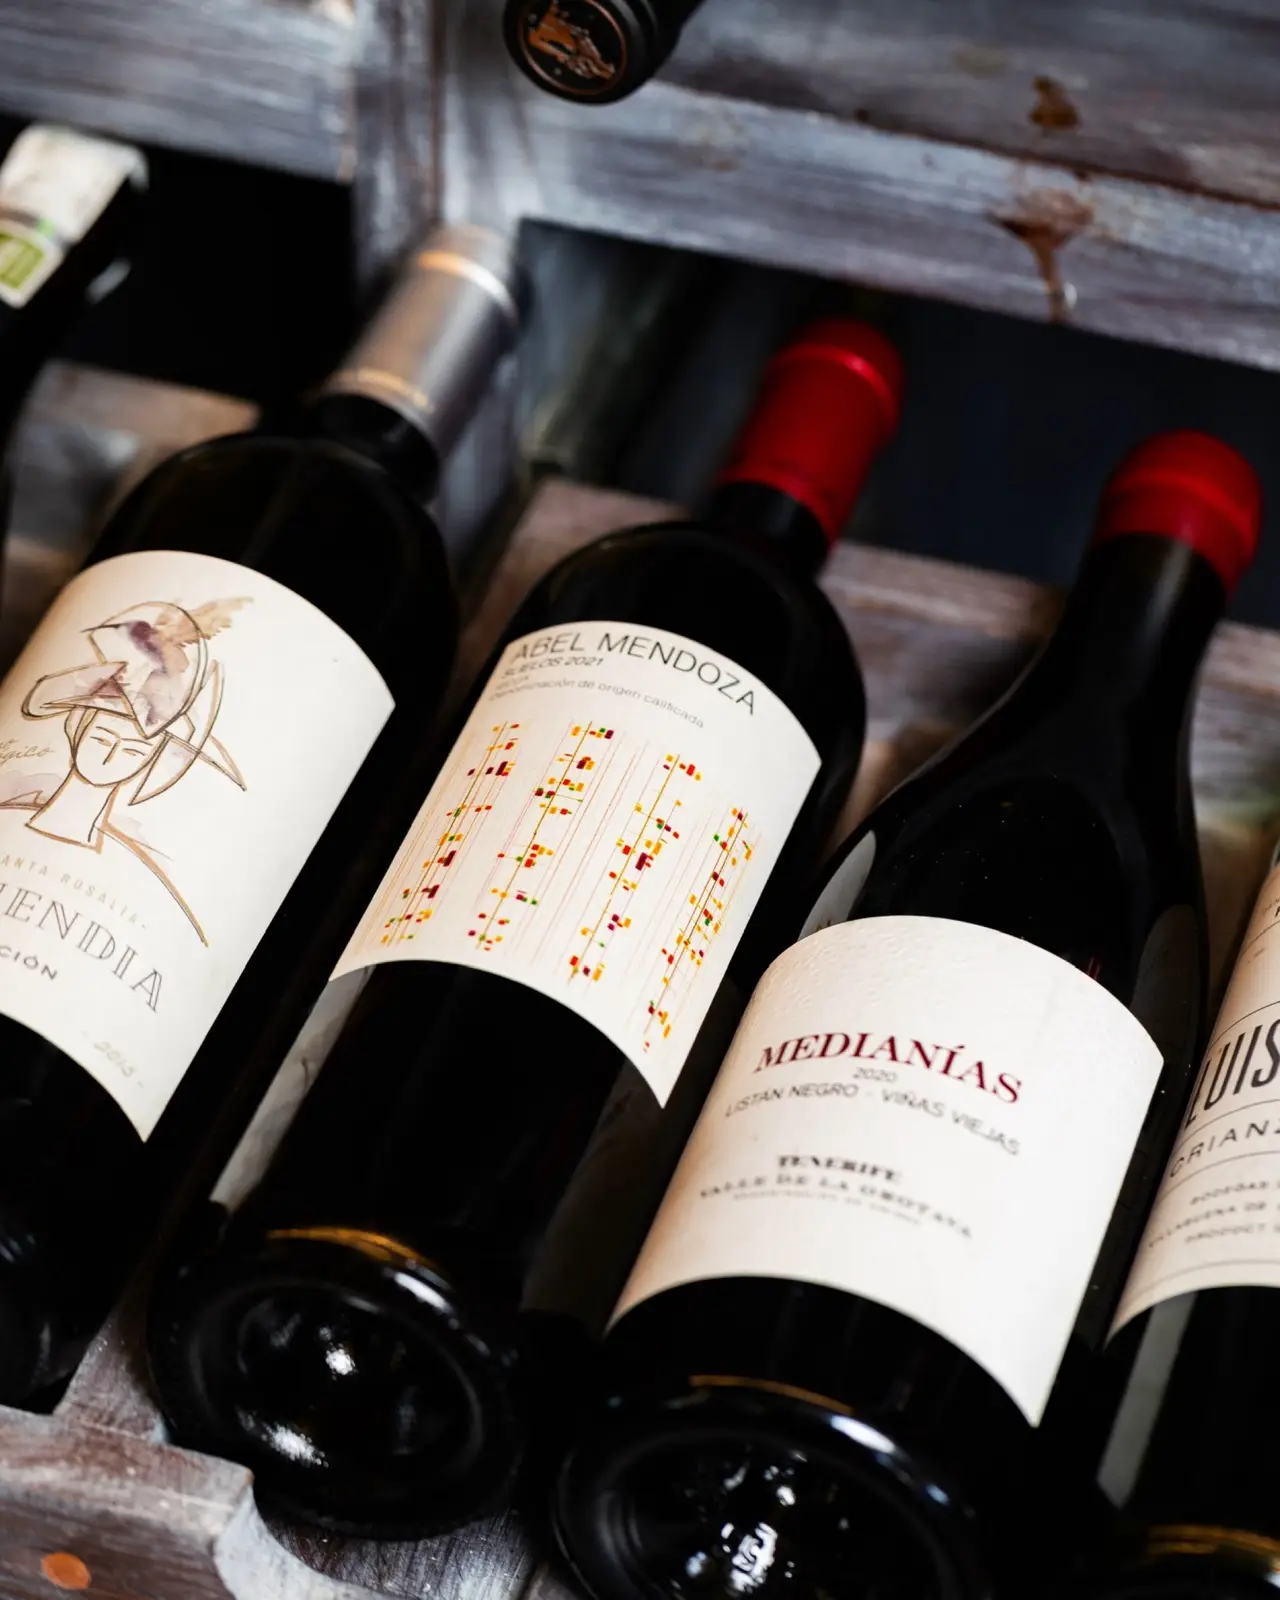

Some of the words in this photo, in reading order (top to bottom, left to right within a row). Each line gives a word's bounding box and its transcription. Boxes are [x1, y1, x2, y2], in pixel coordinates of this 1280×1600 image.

[509, 632, 586, 664] ABEL
[597, 632, 757, 716] MENDOZA
[564, 655, 605, 668] 2021
[577, 679, 595, 689] de
[598, 681, 641, 700] origen
[643, 693, 705, 729] calificada
[0, 882, 164, 1014] ENDIA
[752, 1031, 1023, 1105] MEDIANÍAS
[852, 1066, 898, 1083] 2020
[788, 1082, 859, 1099] NEGRO
[882, 1087, 945, 1119] VIÑAS
[952, 1108, 1020, 1156] VIEJAS
[776, 1154, 904, 1183] TENERIFE
[1169, 1119, 1280, 1179] CRIAN
[776, 1172, 808, 1187] DE
[818, 1175, 849, 1192] LA
